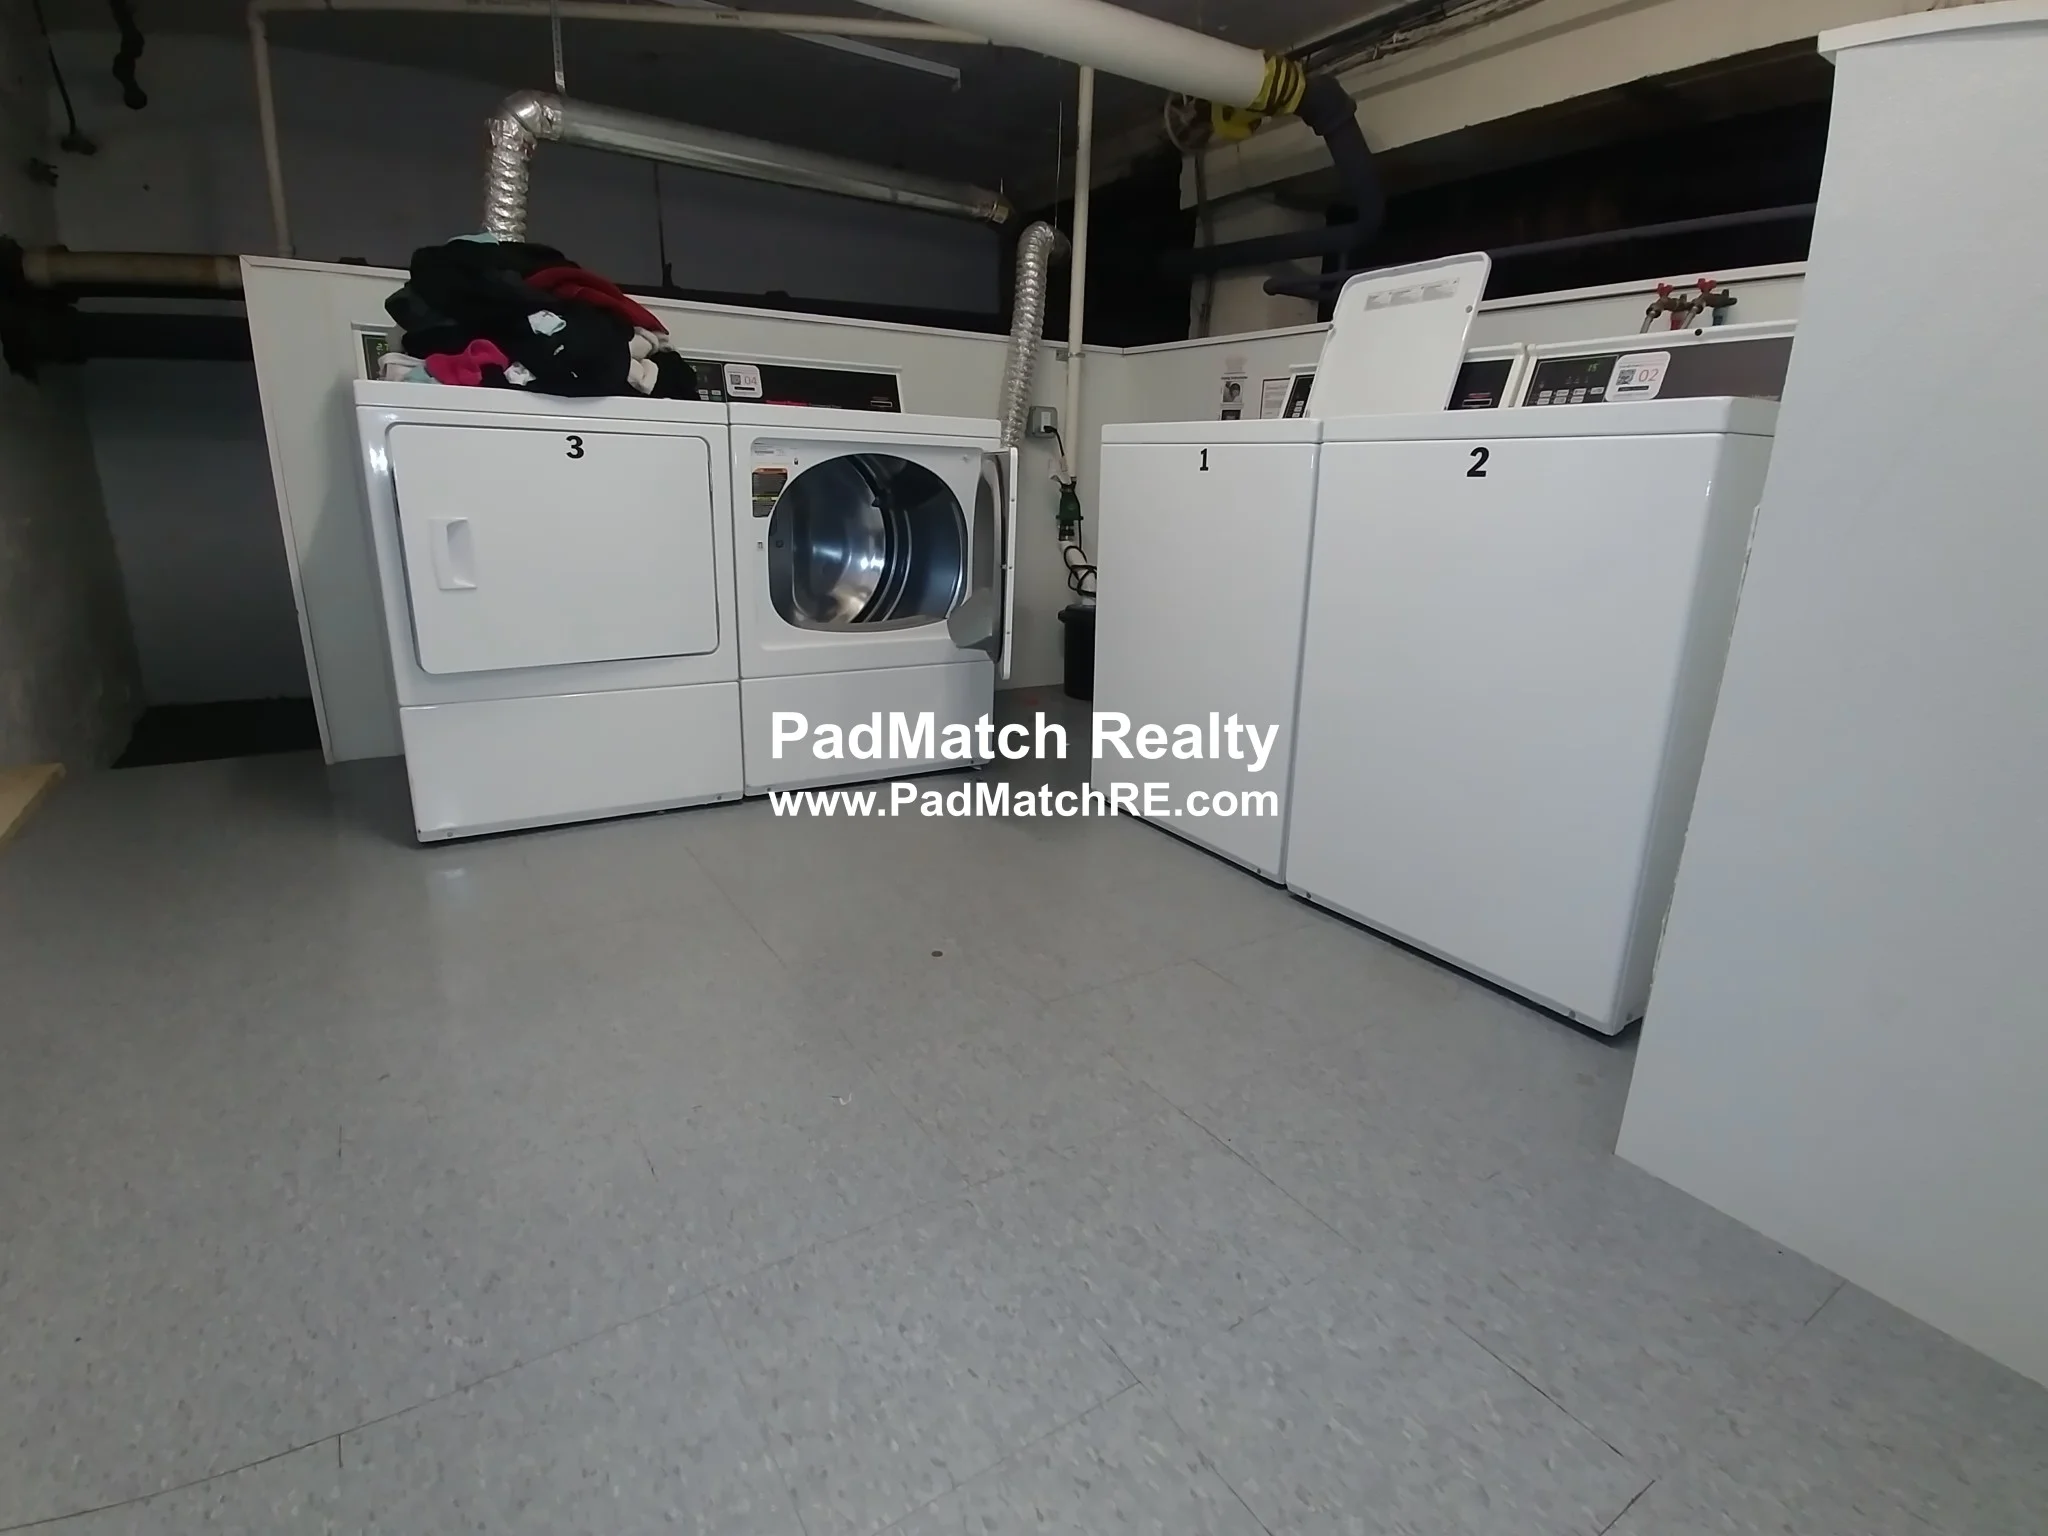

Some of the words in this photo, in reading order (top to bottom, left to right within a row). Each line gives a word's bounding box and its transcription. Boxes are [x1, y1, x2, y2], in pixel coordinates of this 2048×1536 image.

[744, 375, 757, 385] 04
[1638, 368, 1659, 382] 02
[566, 435, 584, 459] 3
[1200, 448, 1209, 471] 1
[1467, 446, 1490, 477] 2
